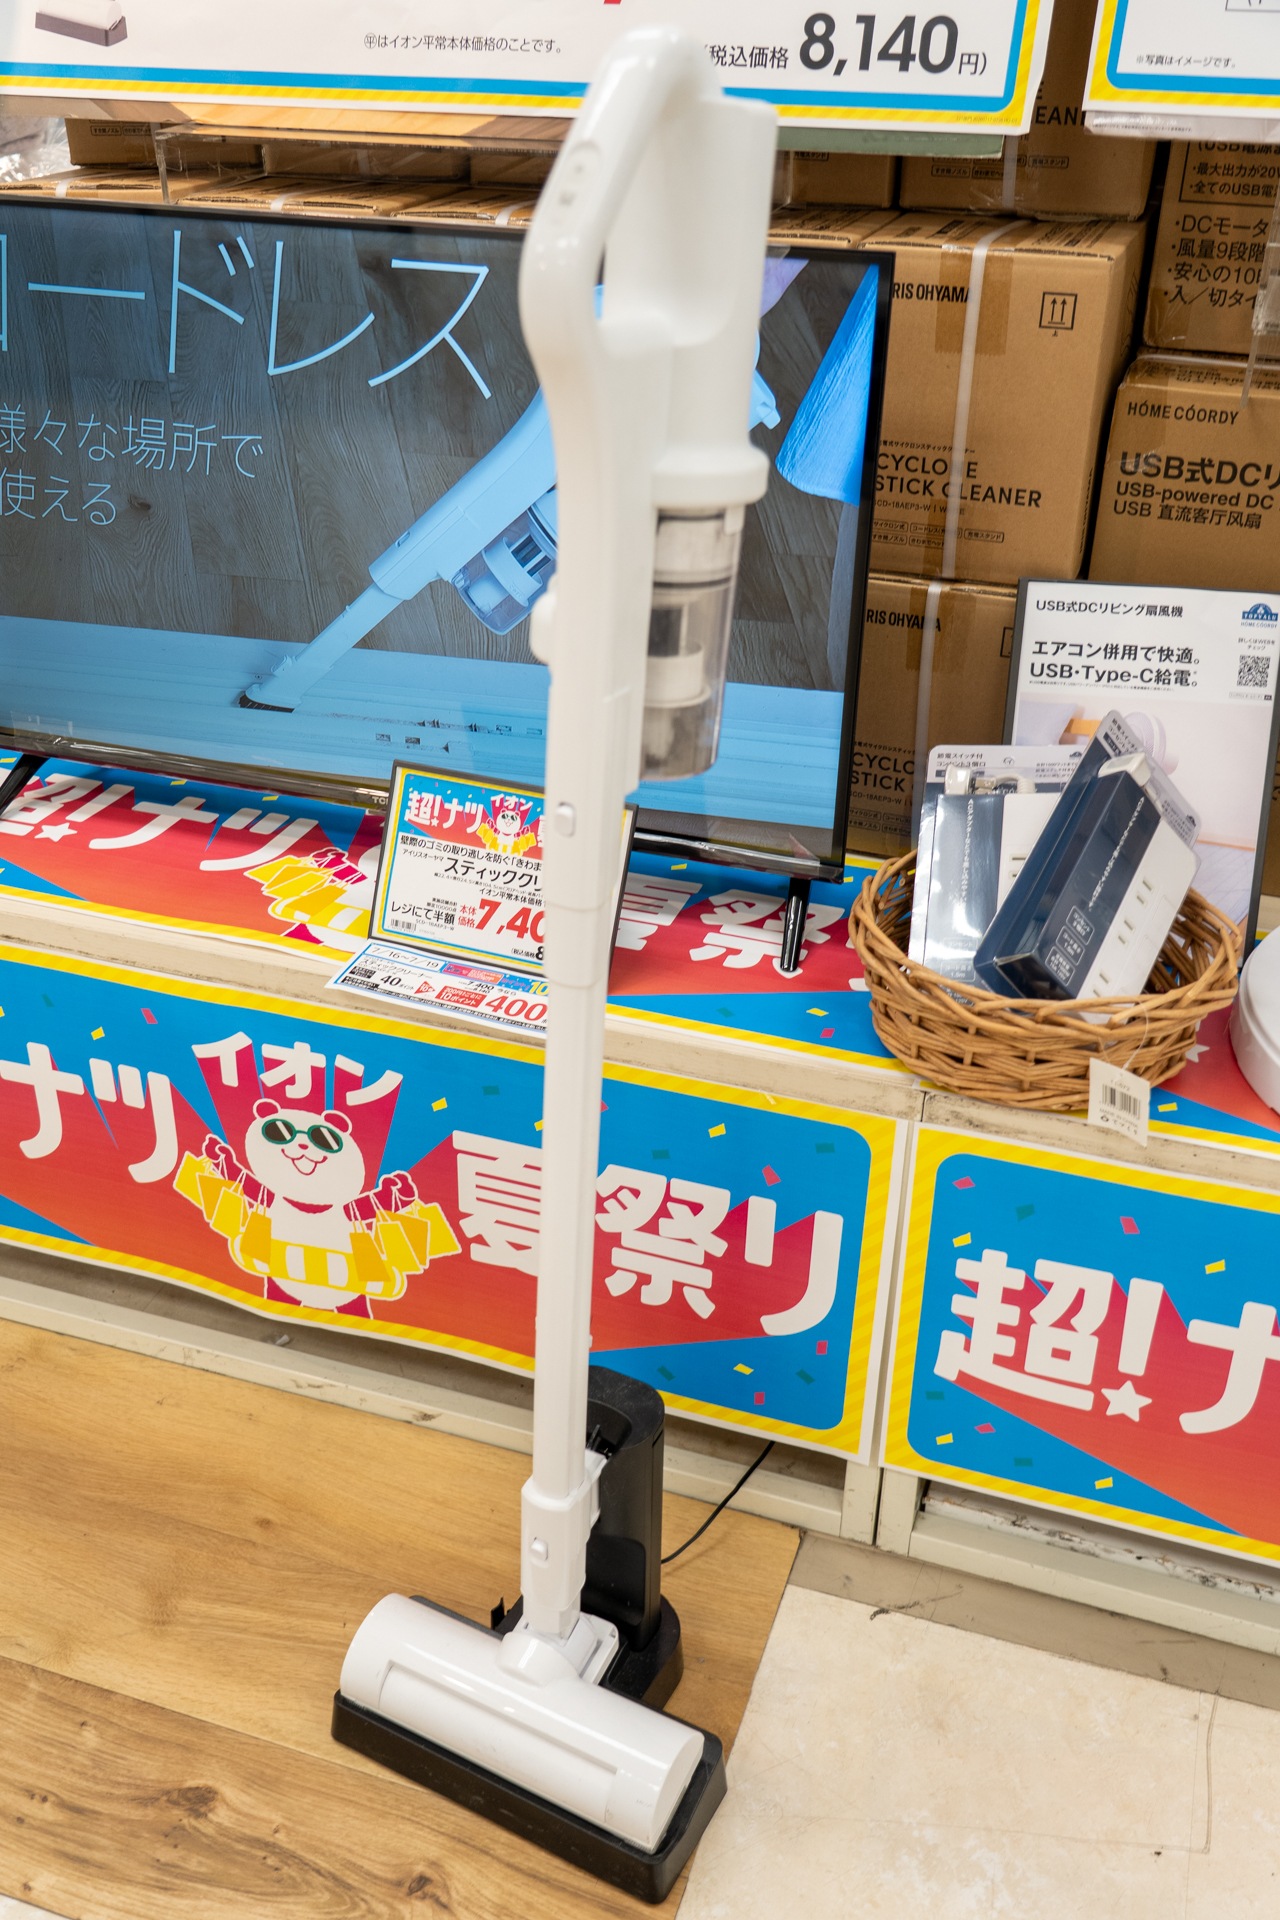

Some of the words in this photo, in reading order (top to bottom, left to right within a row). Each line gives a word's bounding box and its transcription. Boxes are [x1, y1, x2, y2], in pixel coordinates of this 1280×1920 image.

[705, 44, 789, 69] 税込価格
[799, 12, 959, 76] 8,140
[877, 452, 979, 479] CYCLOE
[0, 467, 117, 526] 使える
[875, 474, 935, 498] STICK
[1116, 480, 1241, 508] USB-powered
[1245, 493, 1275, 510] DC
[1113, 499, 1152, 518] USB
[1036, 599, 1184, 618] USB式DCリビング扇風機
[1032, 640, 1201, 666] エアコン併用で快適。
[850, 770, 906, 793] STICK
[404, 790, 484, 834] 超!ナツ
[490, 793, 534, 812] イオン
[391, 901, 456, 926] レジにて半額
[457, 915, 476, 928] 価格
[459, 904, 477, 916] 本体
[380, 975, 402, 987] 40
[485, 995, 548, 1022] 400
[191, 1031, 404, 1106] イオン
